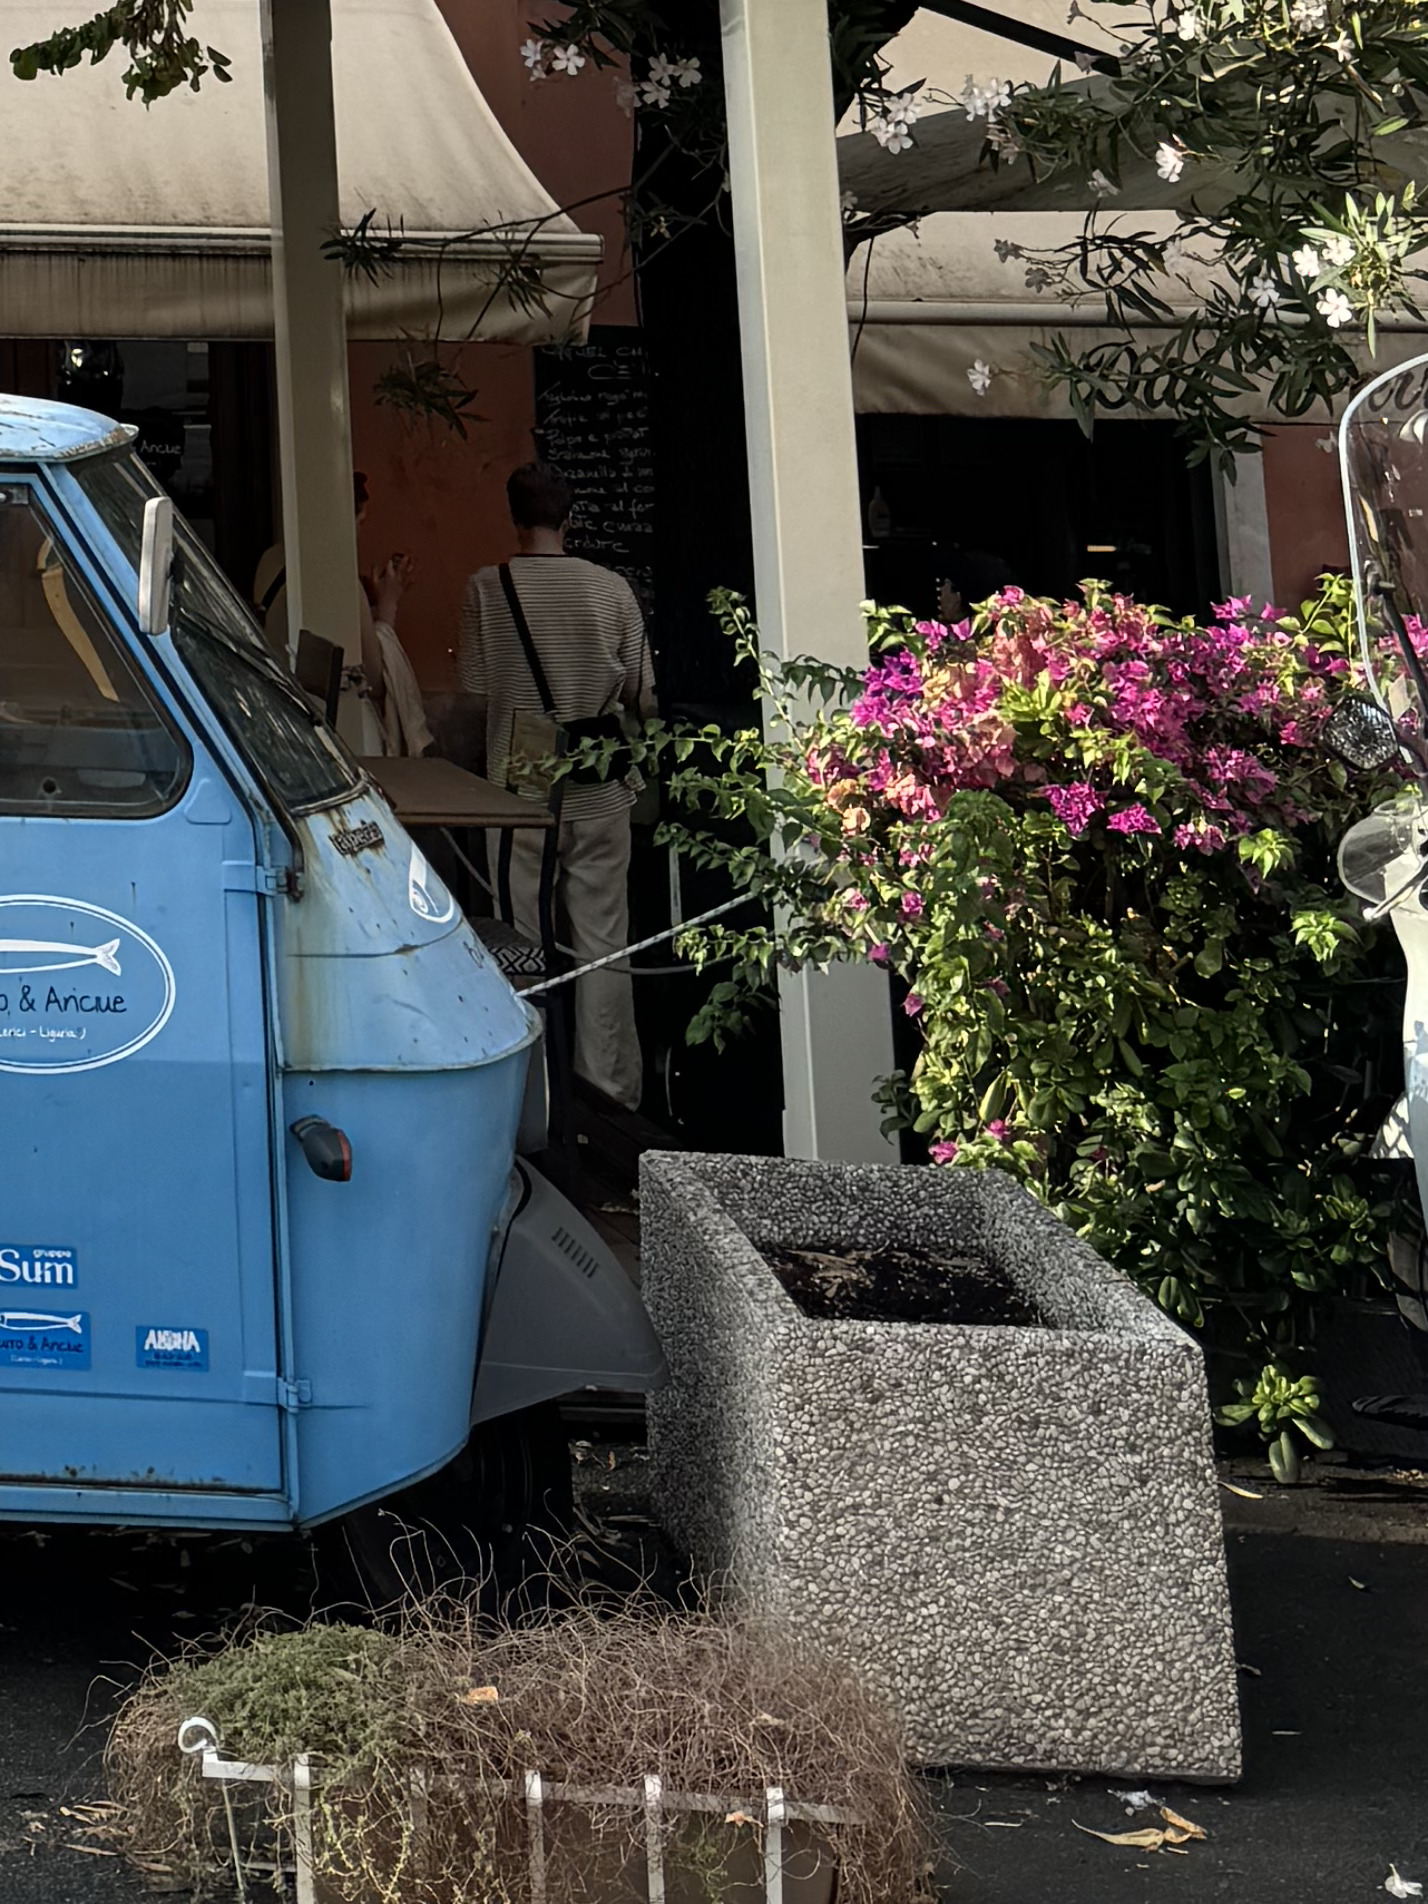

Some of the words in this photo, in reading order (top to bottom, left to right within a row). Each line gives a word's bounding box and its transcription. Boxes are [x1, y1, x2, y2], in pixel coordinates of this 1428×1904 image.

[19, 985, 36, 1012] &
[45, 986, 127, 1013] Anciue
[28, 1336, 38, 1350] &
